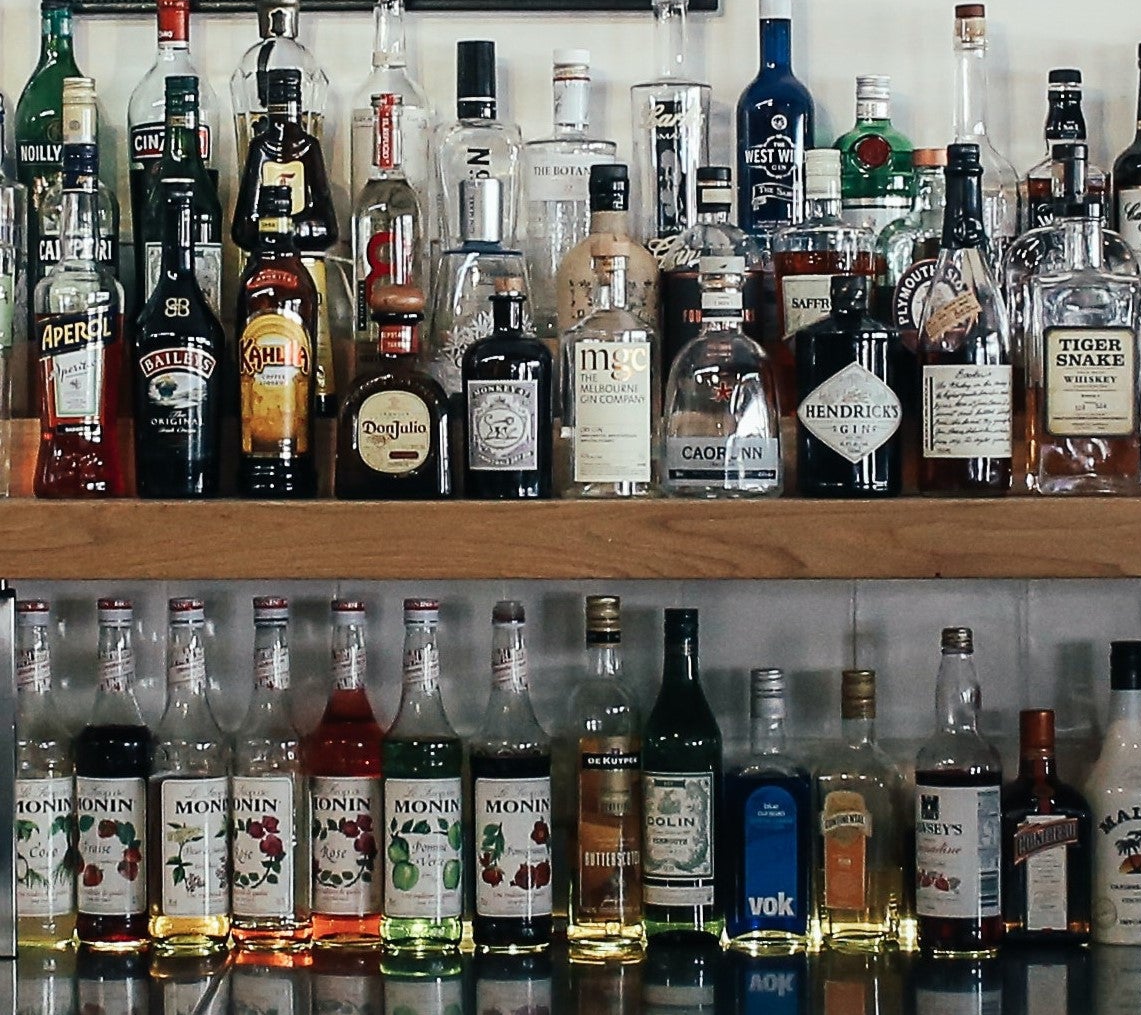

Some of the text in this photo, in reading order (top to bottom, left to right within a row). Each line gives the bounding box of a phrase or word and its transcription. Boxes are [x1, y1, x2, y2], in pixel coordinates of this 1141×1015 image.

[20, 144, 63, 162] NOILLY
[745, 148, 775, 163] WEST
[1059, 338, 1122, 352] TIGER
[239, 337, 310, 375] KAHLA
[1056, 354, 1125, 367] SNAKE
[681, 446, 763, 461] CAORNN
[748, 891, 796, 917] vok
